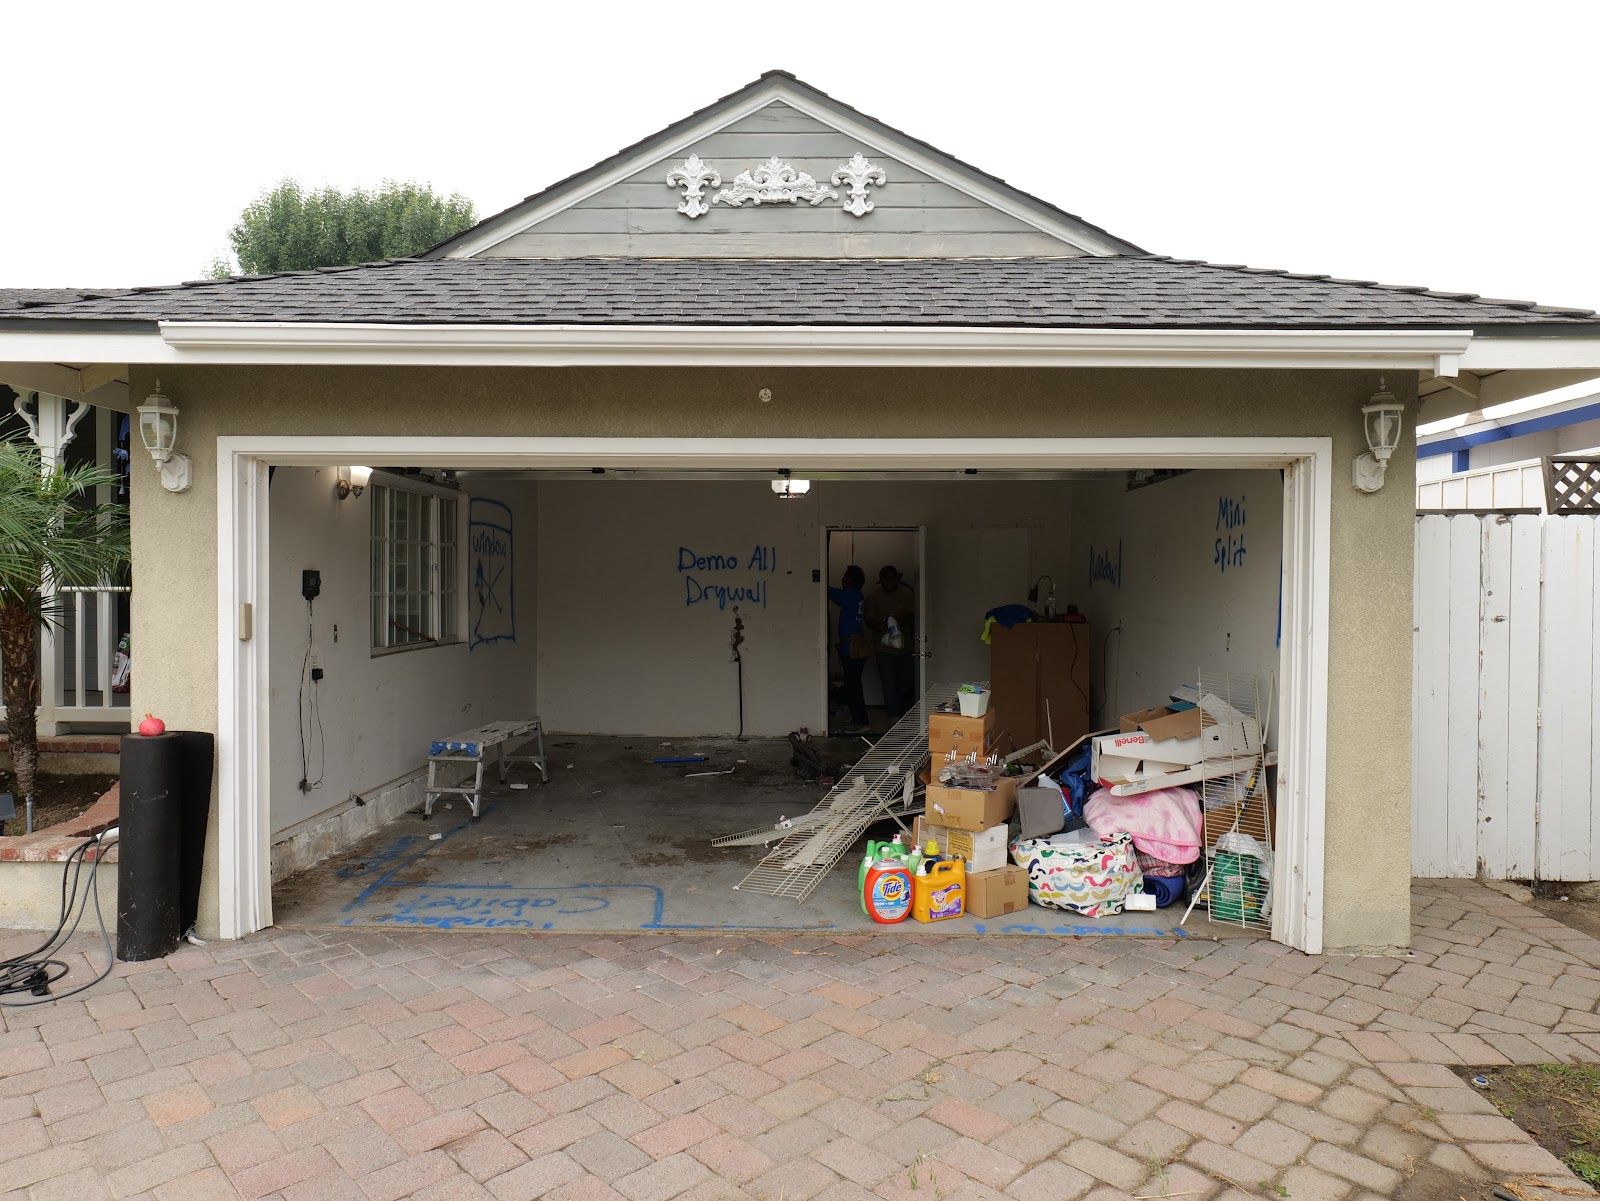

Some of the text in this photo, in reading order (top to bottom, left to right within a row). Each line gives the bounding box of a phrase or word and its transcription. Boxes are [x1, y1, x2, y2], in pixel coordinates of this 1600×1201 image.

[1216, 495, 1247, 531] Mini
[677, 545, 776, 572] Demo All
[1214, 533, 1247, 574] Split
[686, 575, 767, 610] Drywall
[883, 881, 902, 897] Tide
